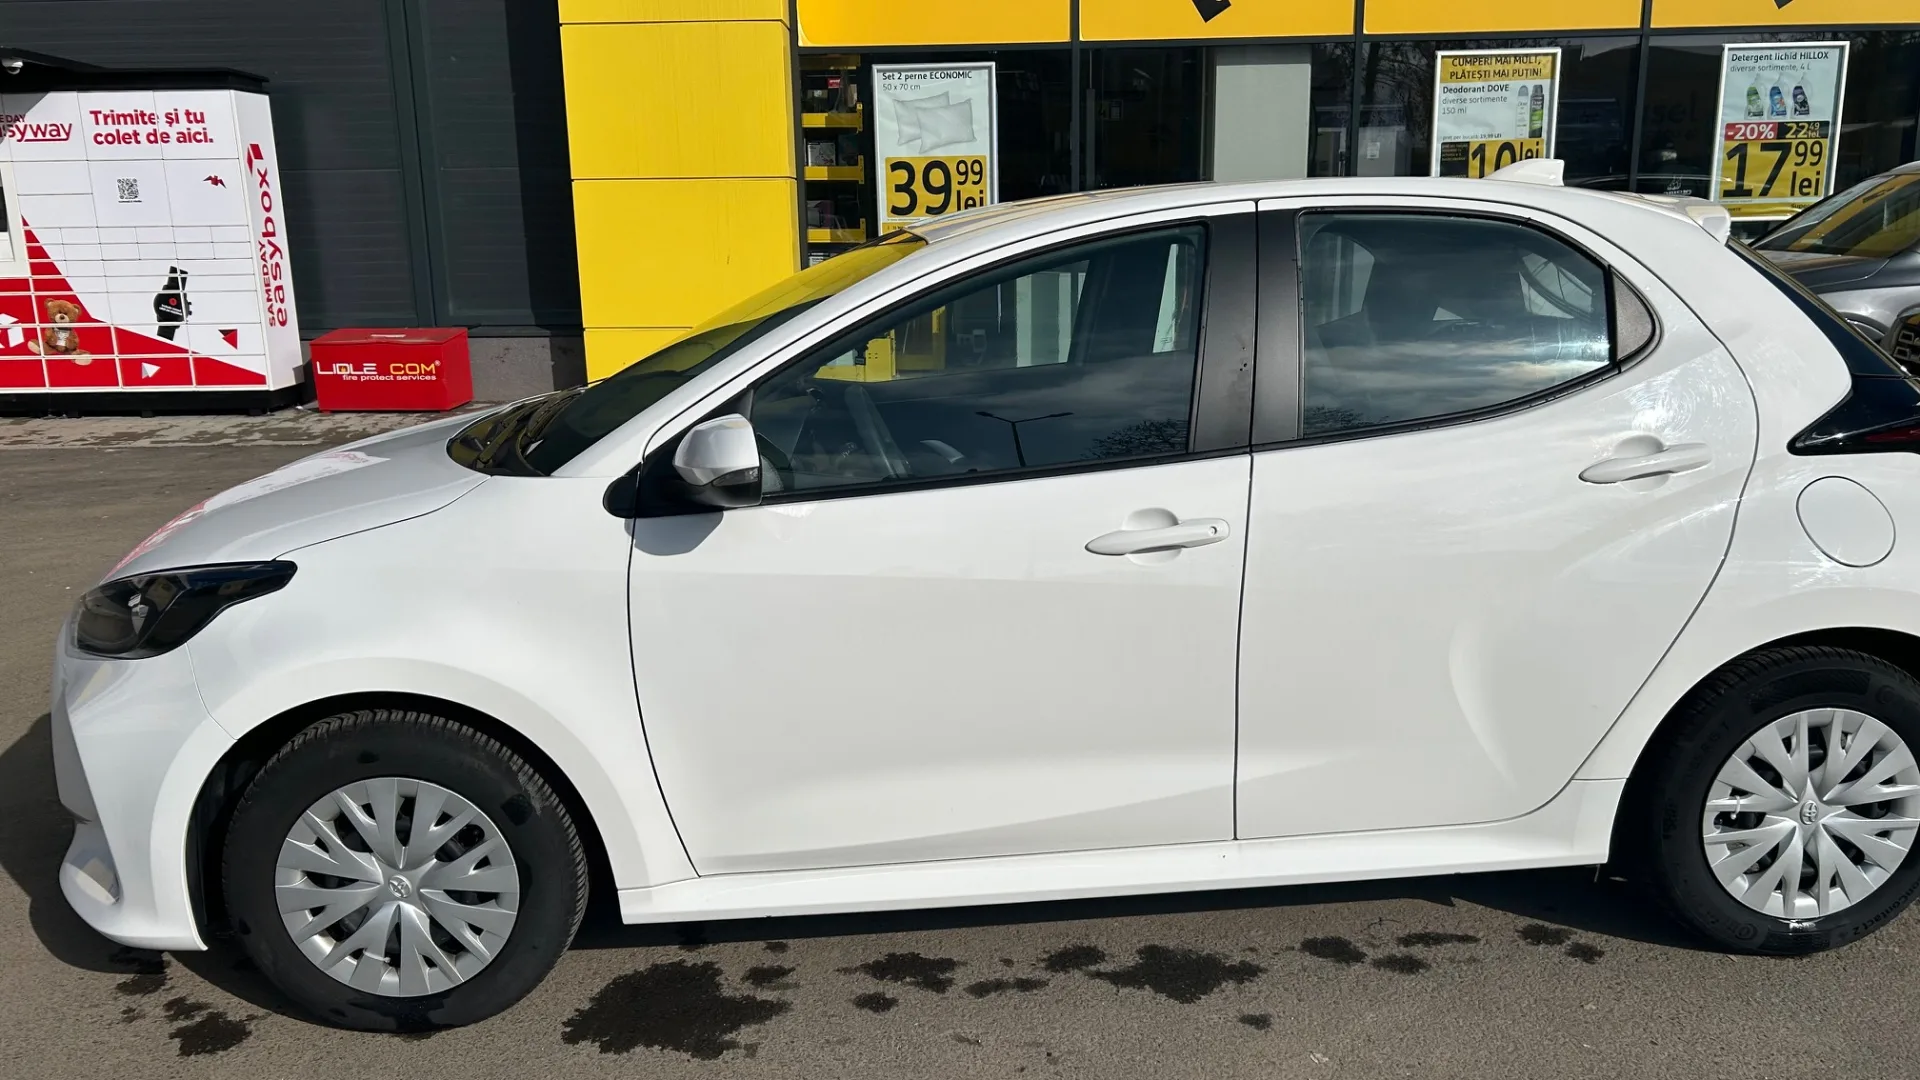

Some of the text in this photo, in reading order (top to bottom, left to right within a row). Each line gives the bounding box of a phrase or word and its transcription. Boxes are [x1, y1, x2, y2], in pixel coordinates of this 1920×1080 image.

[1451, 56, 1492, 67] CUMPERI
[1494, 56, 1511, 65] MAI
[1731, 51, 1829, 63] Detergent lichid HILLOX
[882, 71, 972, 81] Set 2 perne ECONOMIC
[1492, 69, 1510, 78] MAI
[1730, 65, 1756, 73] diverse
[1757, 64, 1799, 72] sortimente,
[882, 83, 892, 91] 50
[900, 83, 909, 91] 70
[1442, 84, 1510, 95] Deodorant DOVE
[1442, 95, 1508, 105] diverse sortimente
[89, 109, 160, 126] Trimite
[184, 109, 205, 124] tu
[1442, 107, 1456, 115] 150
[0, 122, 73, 143] syway
[93, 127, 214, 145] colet de aici.
[1727, 124, 1775, 140] -20%
[1785, 122, 1808, 139] 22
[1471, 141, 1517, 178] 10
[1519, 141, 1540, 161] lei
[1722, 140, 1824, 198] 17 99
[890, 159, 984, 216] 39 99
[1790, 170, 1821, 197] lei
[956, 190, 984, 212] lei
[257, 168, 288, 327] easybox
[258, 240, 276, 327] SAMEDAY
[361, 374, 394, 382] protect
